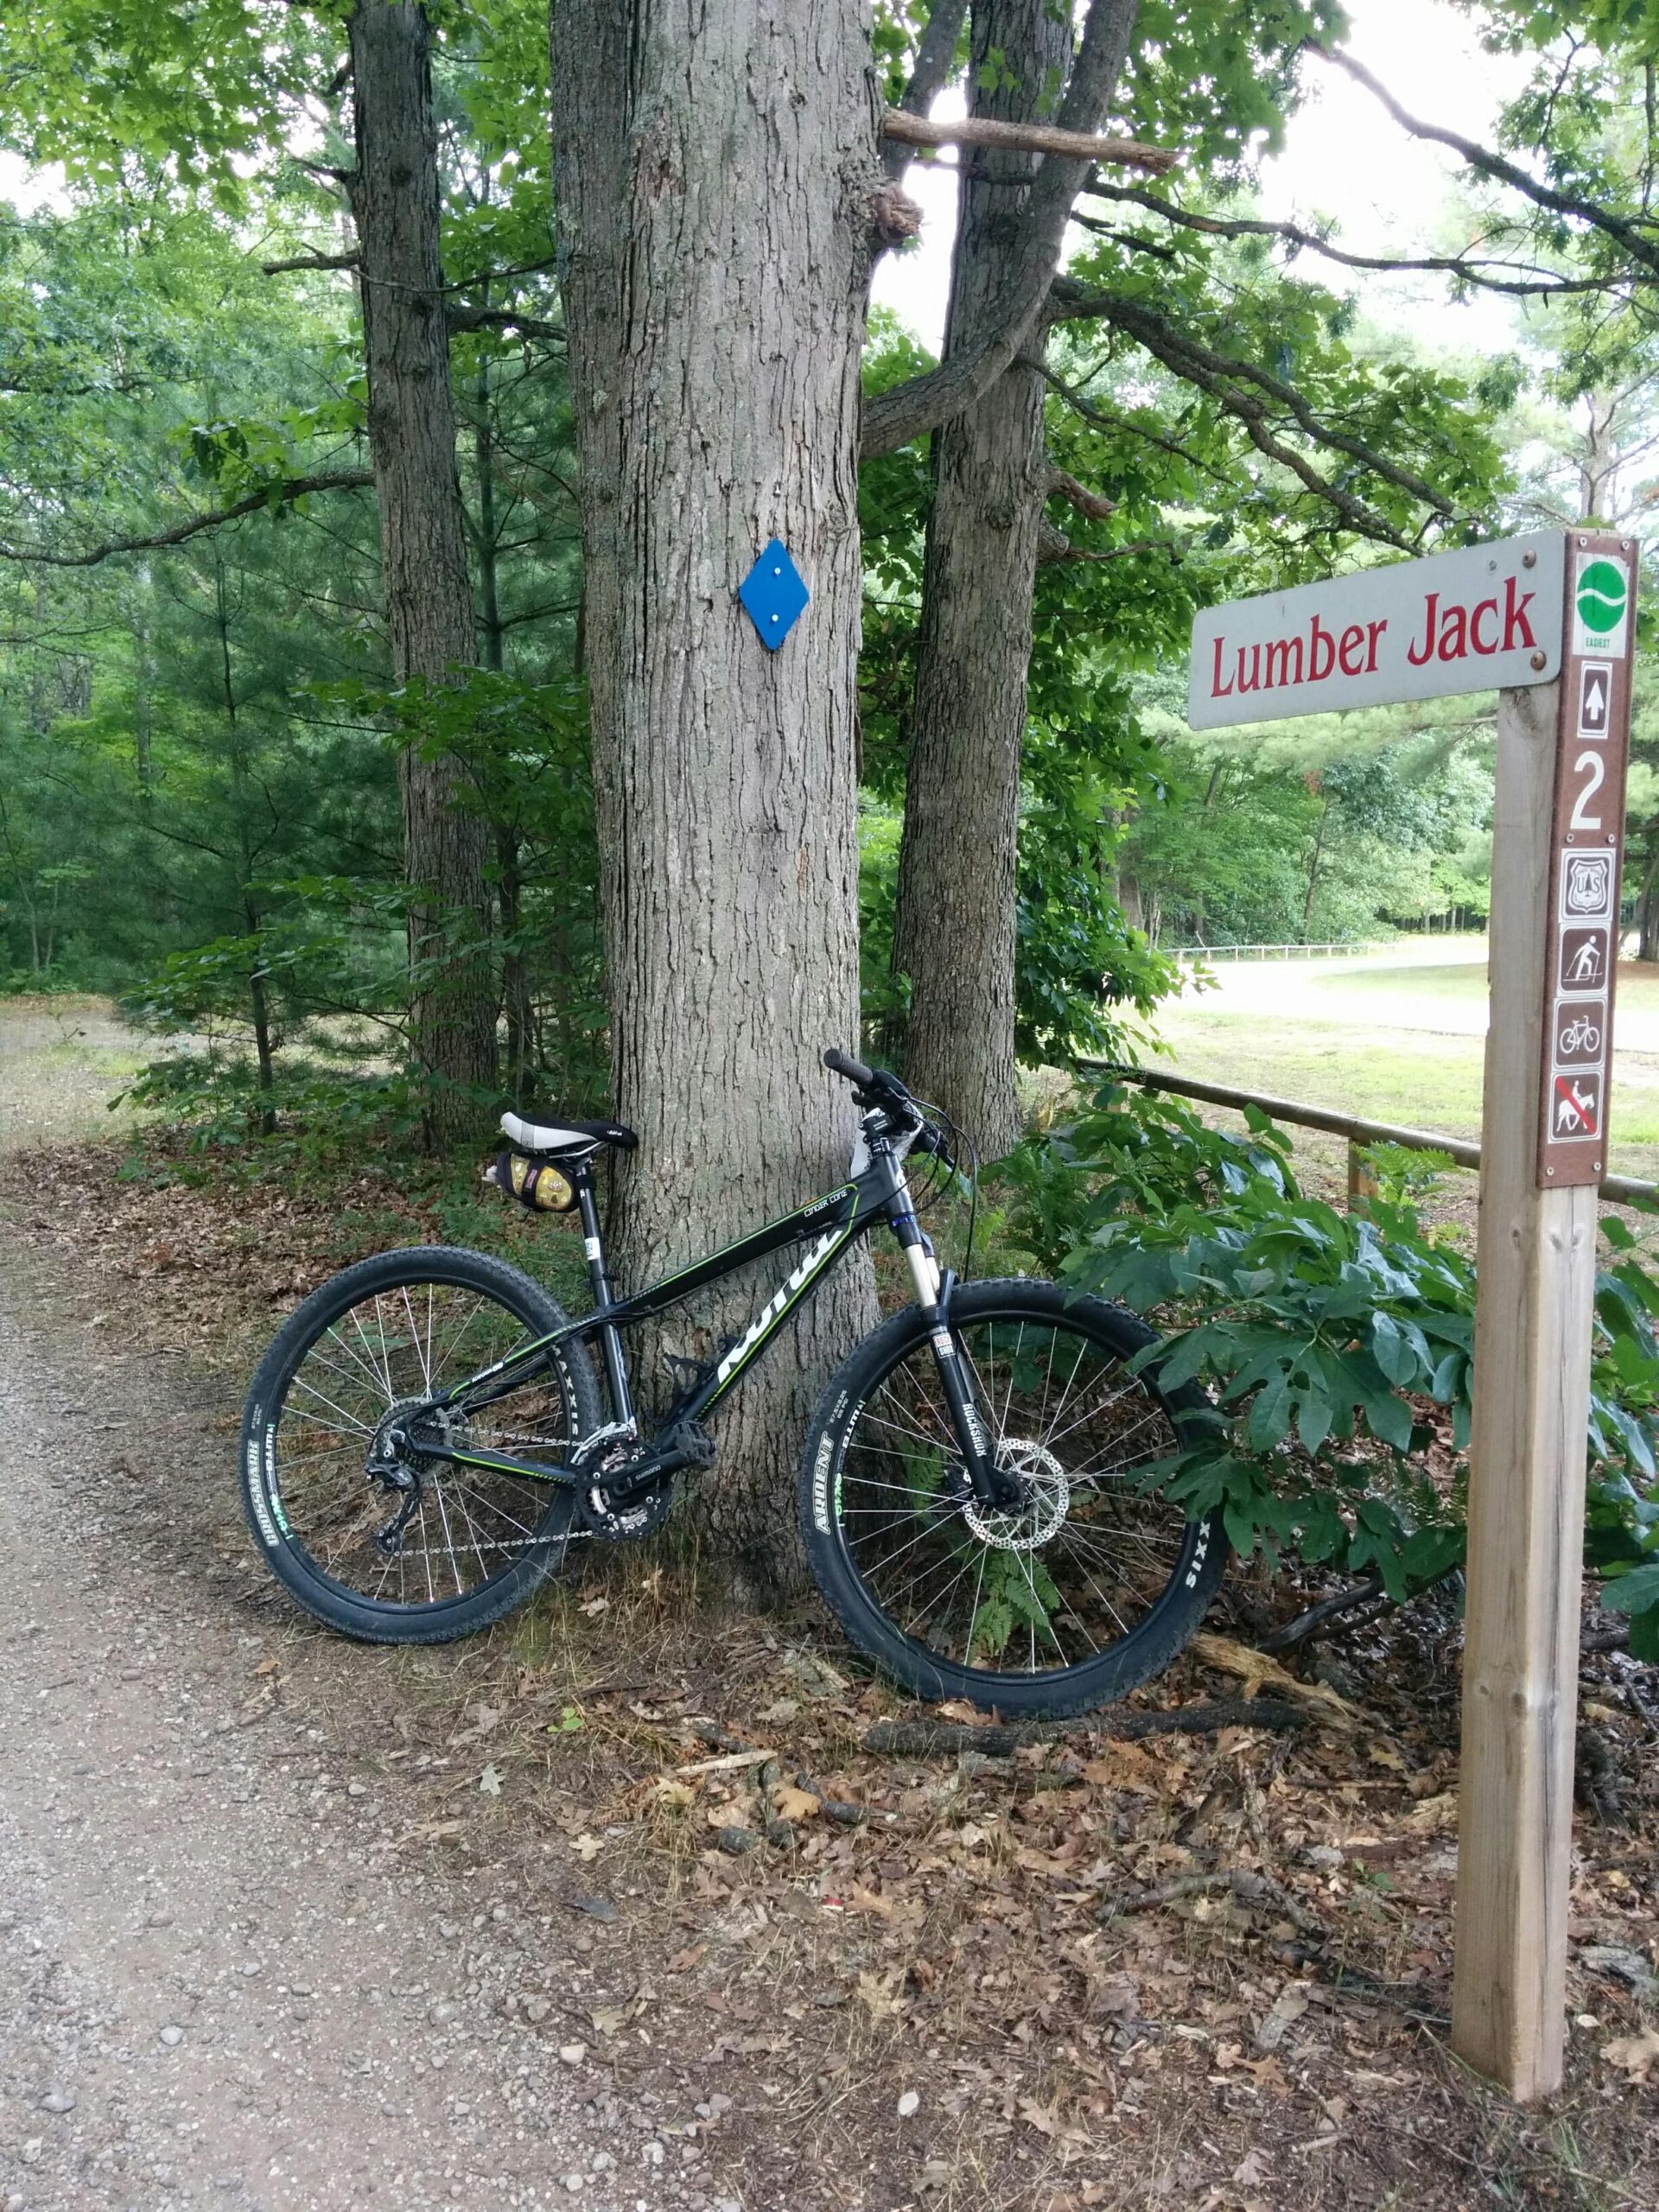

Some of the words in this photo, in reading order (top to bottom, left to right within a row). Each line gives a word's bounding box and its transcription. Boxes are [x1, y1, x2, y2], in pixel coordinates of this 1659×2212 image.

[1210, 613, 1389, 698] Lumber
[1407, 575, 1537, 666] Jack
[1586, 637, 1611, 648] EASIEST
[1570, 750, 1605, 830] 2
[962, 1403, 988, 1458] ROCKSHOX
[247, 1439, 280, 1548] CROSSMARK
[813, 1431, 835, 1535] ARDENT
[1185, 1520, 1211, 1589] XXIS
